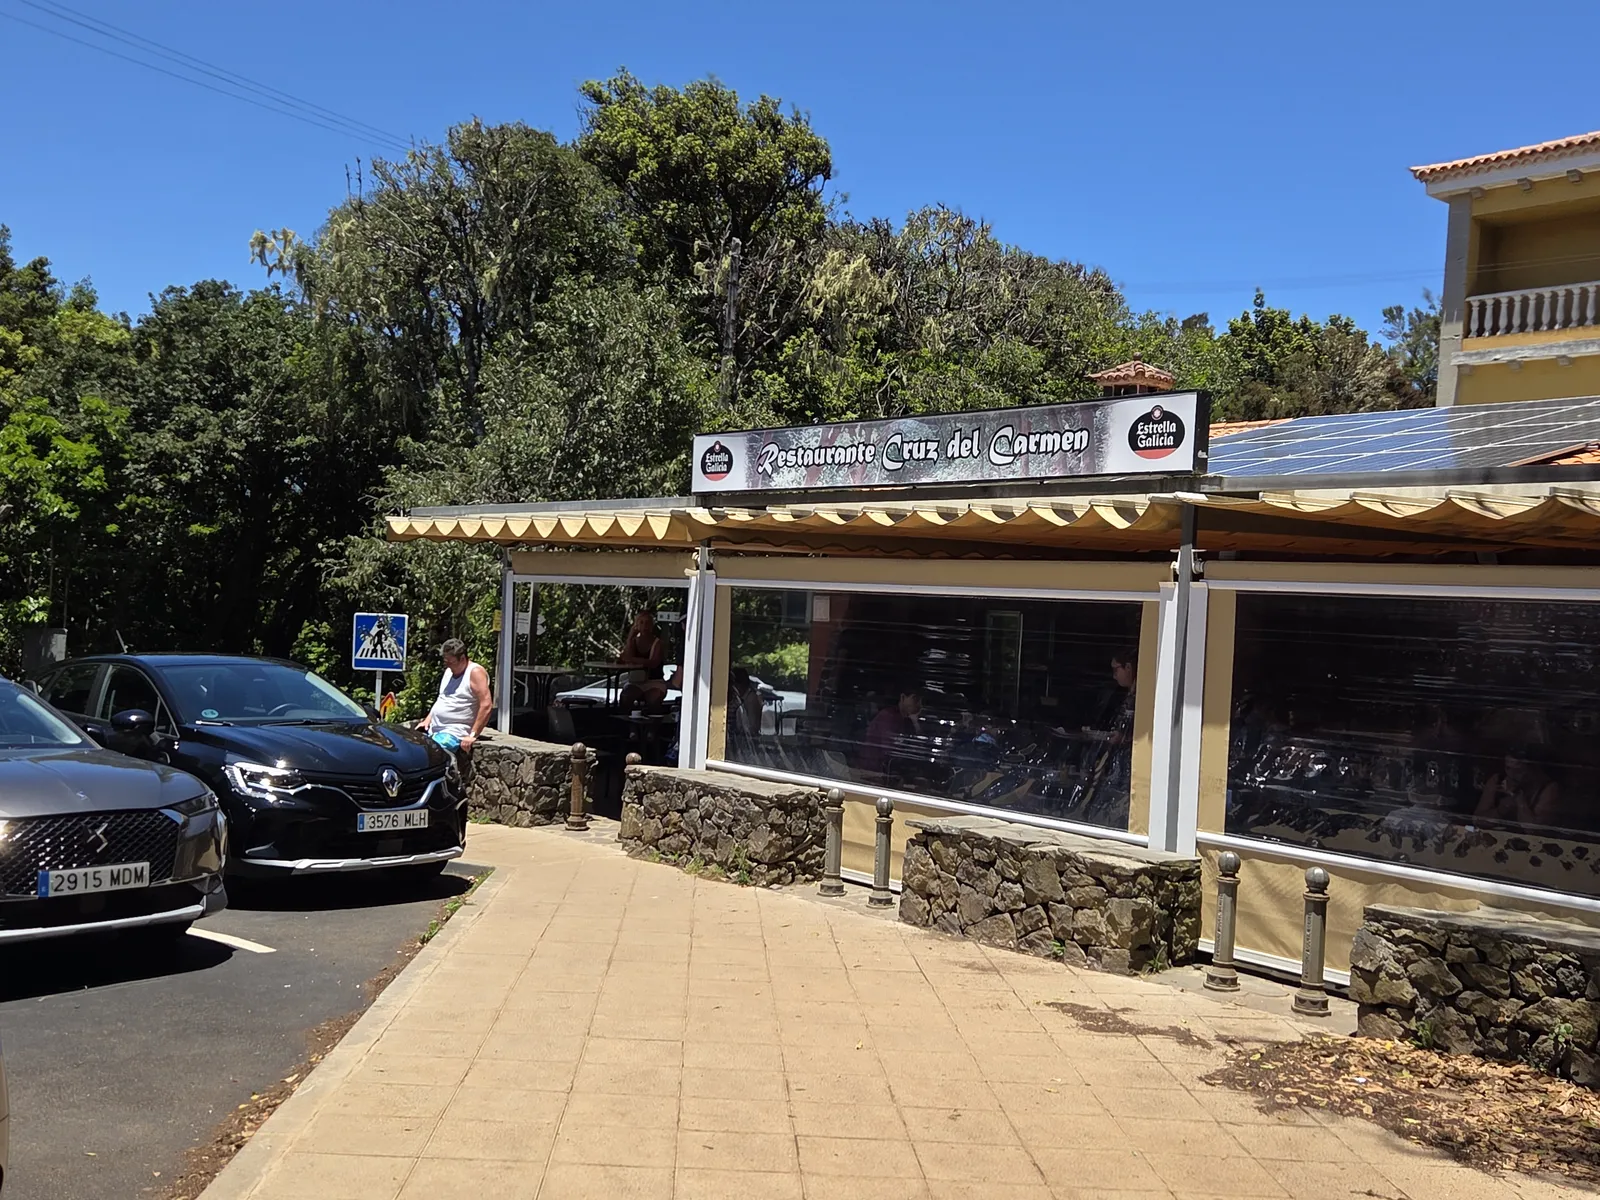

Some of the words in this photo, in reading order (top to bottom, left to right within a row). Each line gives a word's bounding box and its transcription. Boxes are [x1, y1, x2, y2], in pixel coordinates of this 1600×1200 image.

[1136, 420, 1177, 435] Estrella
[1137, 433, 1175, 448] Galicia
[757, 441, 876, 475] Restaurante
[882, 432, 940, 471] Cruz
[946, 427, 981, 459] del
[988, 424, 1091, 466] Carmen
[705, 452, 729, 463] Estrella
[705, 462, 728, 472] Galicia
[368, 814, 399, 829] 3576
[404, 812, 426, 827] MLH
[53, 871, 103, 892] 2915
[109, 866, 145, 887] MDM
